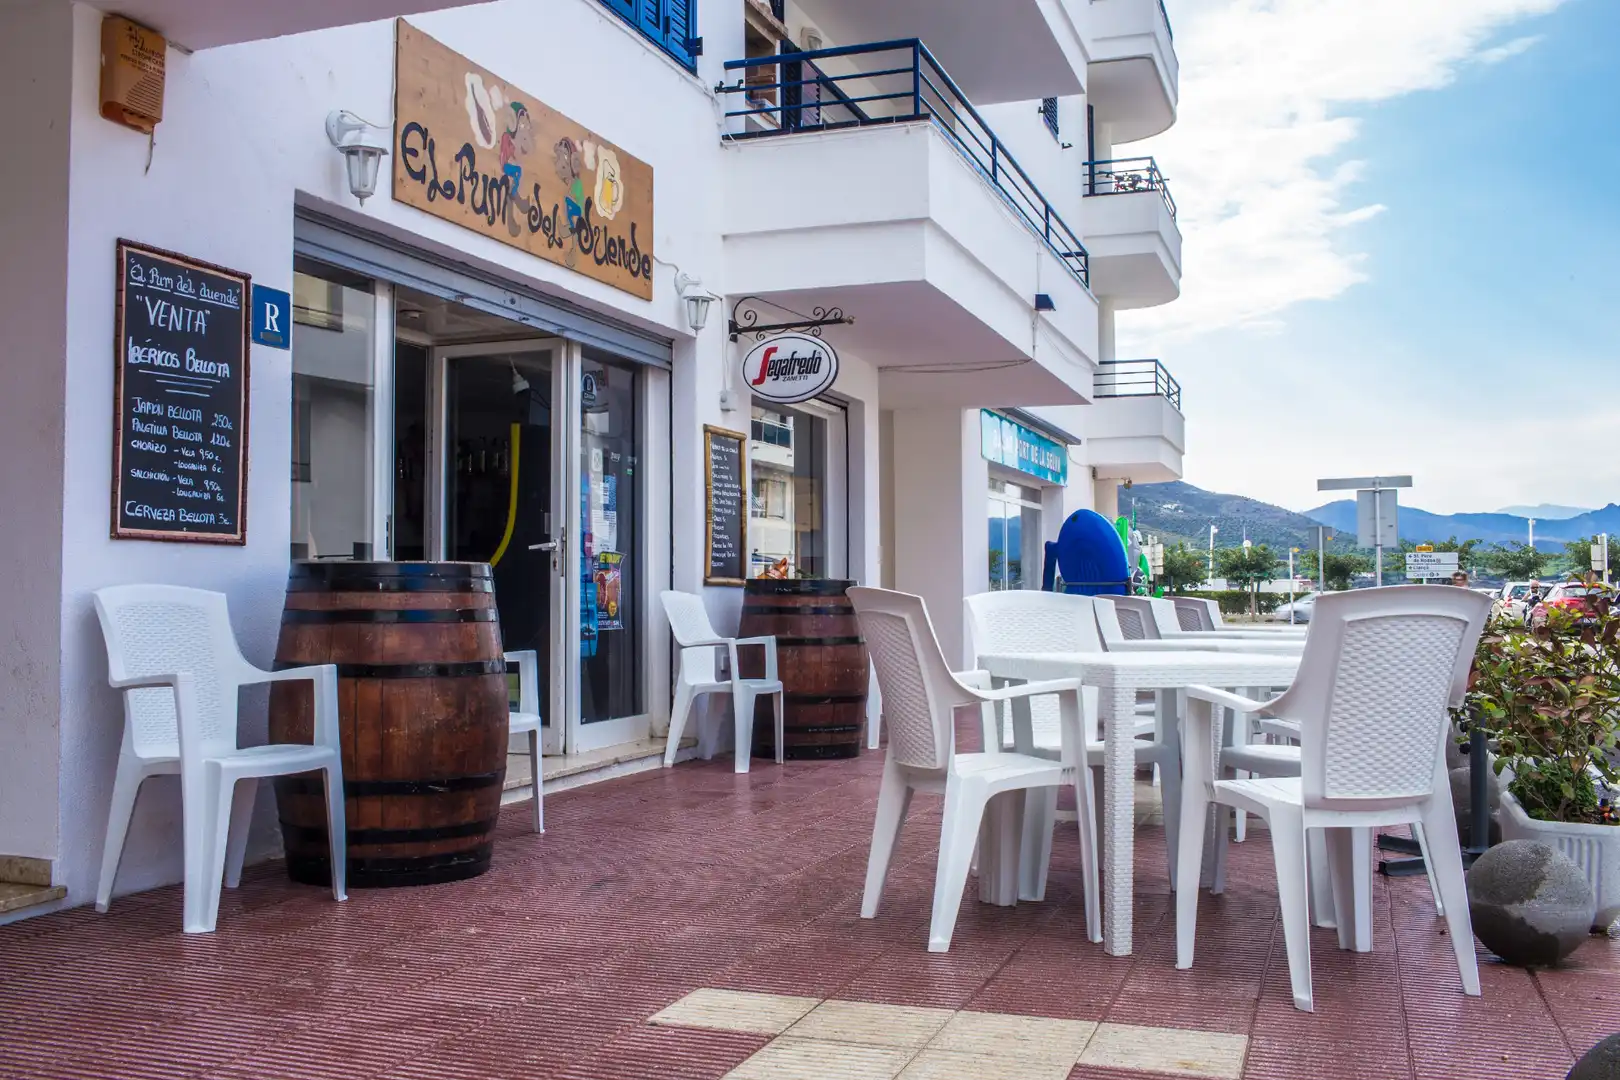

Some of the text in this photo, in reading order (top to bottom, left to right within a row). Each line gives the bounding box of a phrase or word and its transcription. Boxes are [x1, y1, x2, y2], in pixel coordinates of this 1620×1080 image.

[264, 301, 281, 333] R
[752, 345, 822, 386] Segafredo
[125, 500, 176, 521] CERVEZA
[178, 508, 216, 525] BELLOTA
